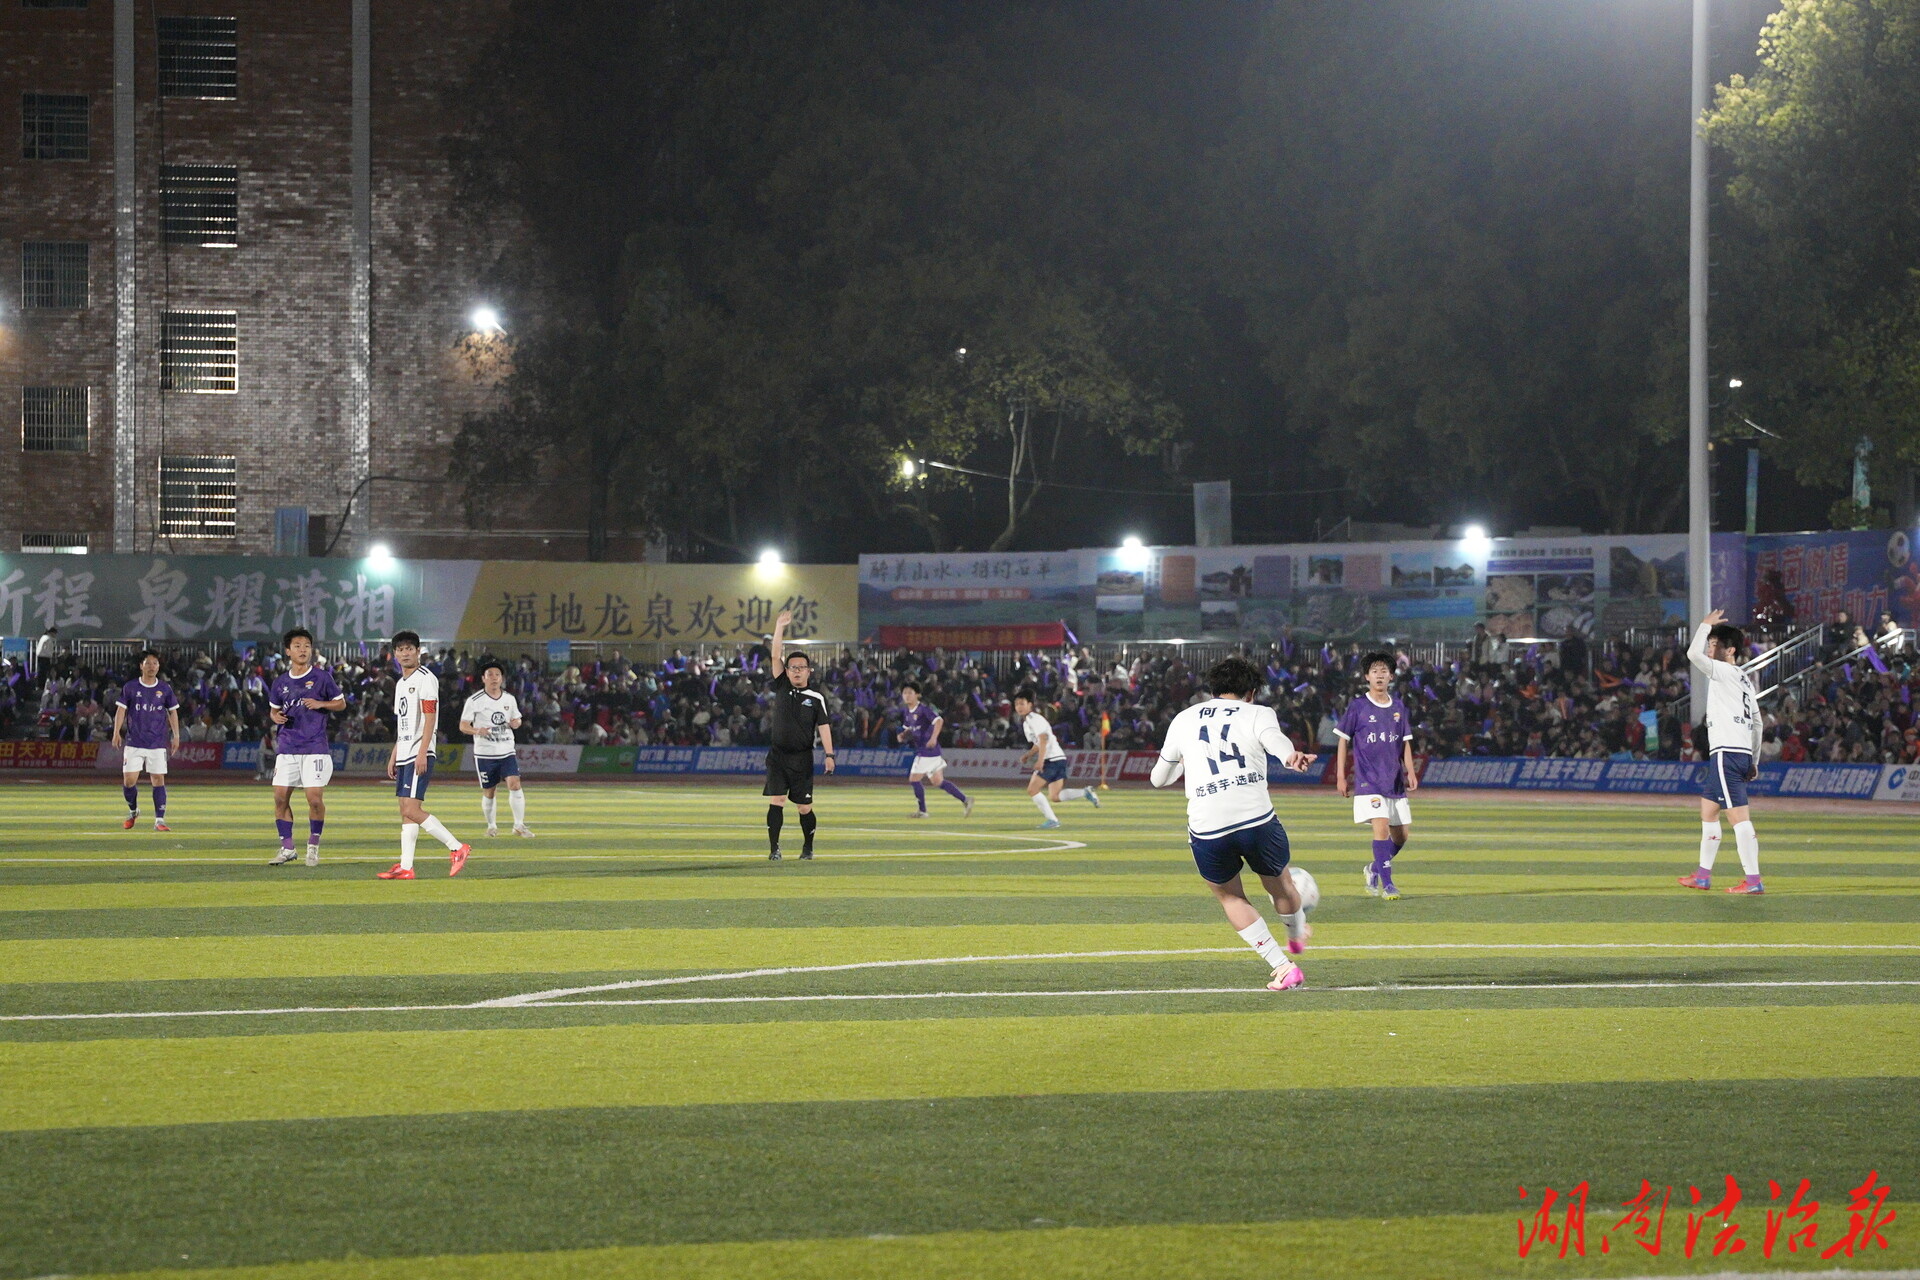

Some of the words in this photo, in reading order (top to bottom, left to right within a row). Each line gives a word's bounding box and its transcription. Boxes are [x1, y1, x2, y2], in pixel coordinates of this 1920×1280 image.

[127, 558, 396, 640] 泉耀潇湘
[493, 590, 820, 640] 福地龙泉欢迎您
[312, 758, 324, 772] 10
[1198, 723, 1247, 776] 14
